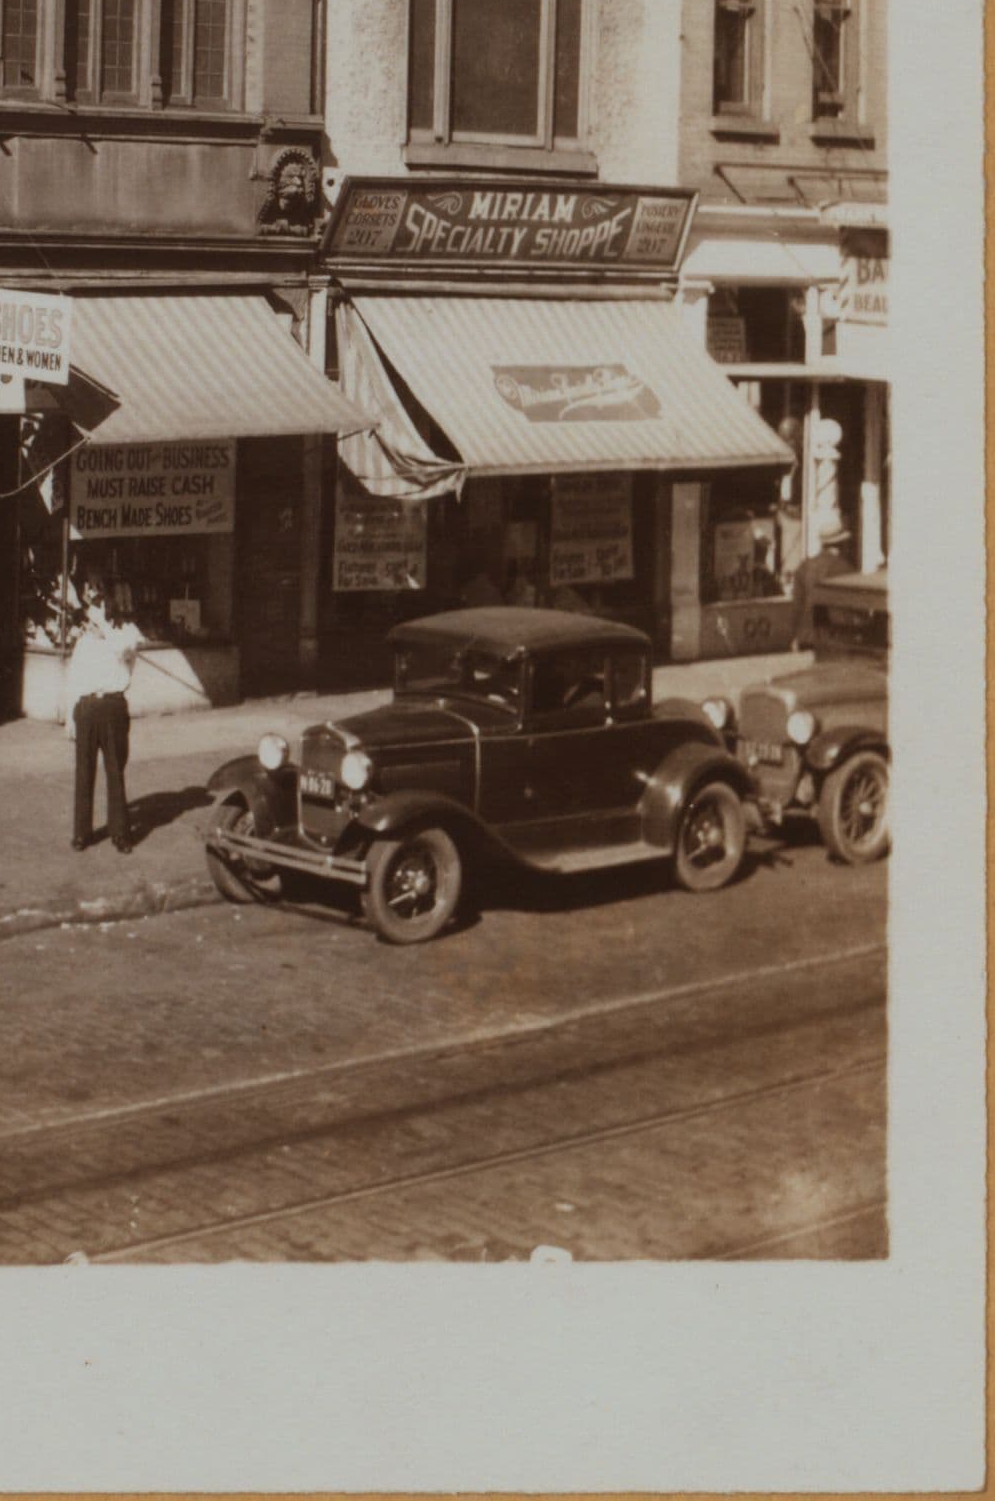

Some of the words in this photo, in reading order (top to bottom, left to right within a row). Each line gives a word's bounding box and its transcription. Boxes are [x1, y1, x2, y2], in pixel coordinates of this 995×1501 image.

[468, 191, 578, 224] MIRIAM
[405, 203, 529, 259] SPECIALTY
[535, 207, 632, 258] SHOPPE
[16, 347, 24, 366] &
[25, 348, 62, 372] WOMEN
[76, 448, 124, 472] GOING
[126, 446, 153, 471] OUT
[161, 445, 229, 470] BUSINESS
[87, 476, 126, 499] MUST
[127, 475, 167, 497] RAISE
[171, 474, 215, 495] CASH
[76, 504, 118, 531] BENCH
[120, 502, 154, 528] MADE
[155, 501, 192, 527] SHOES
